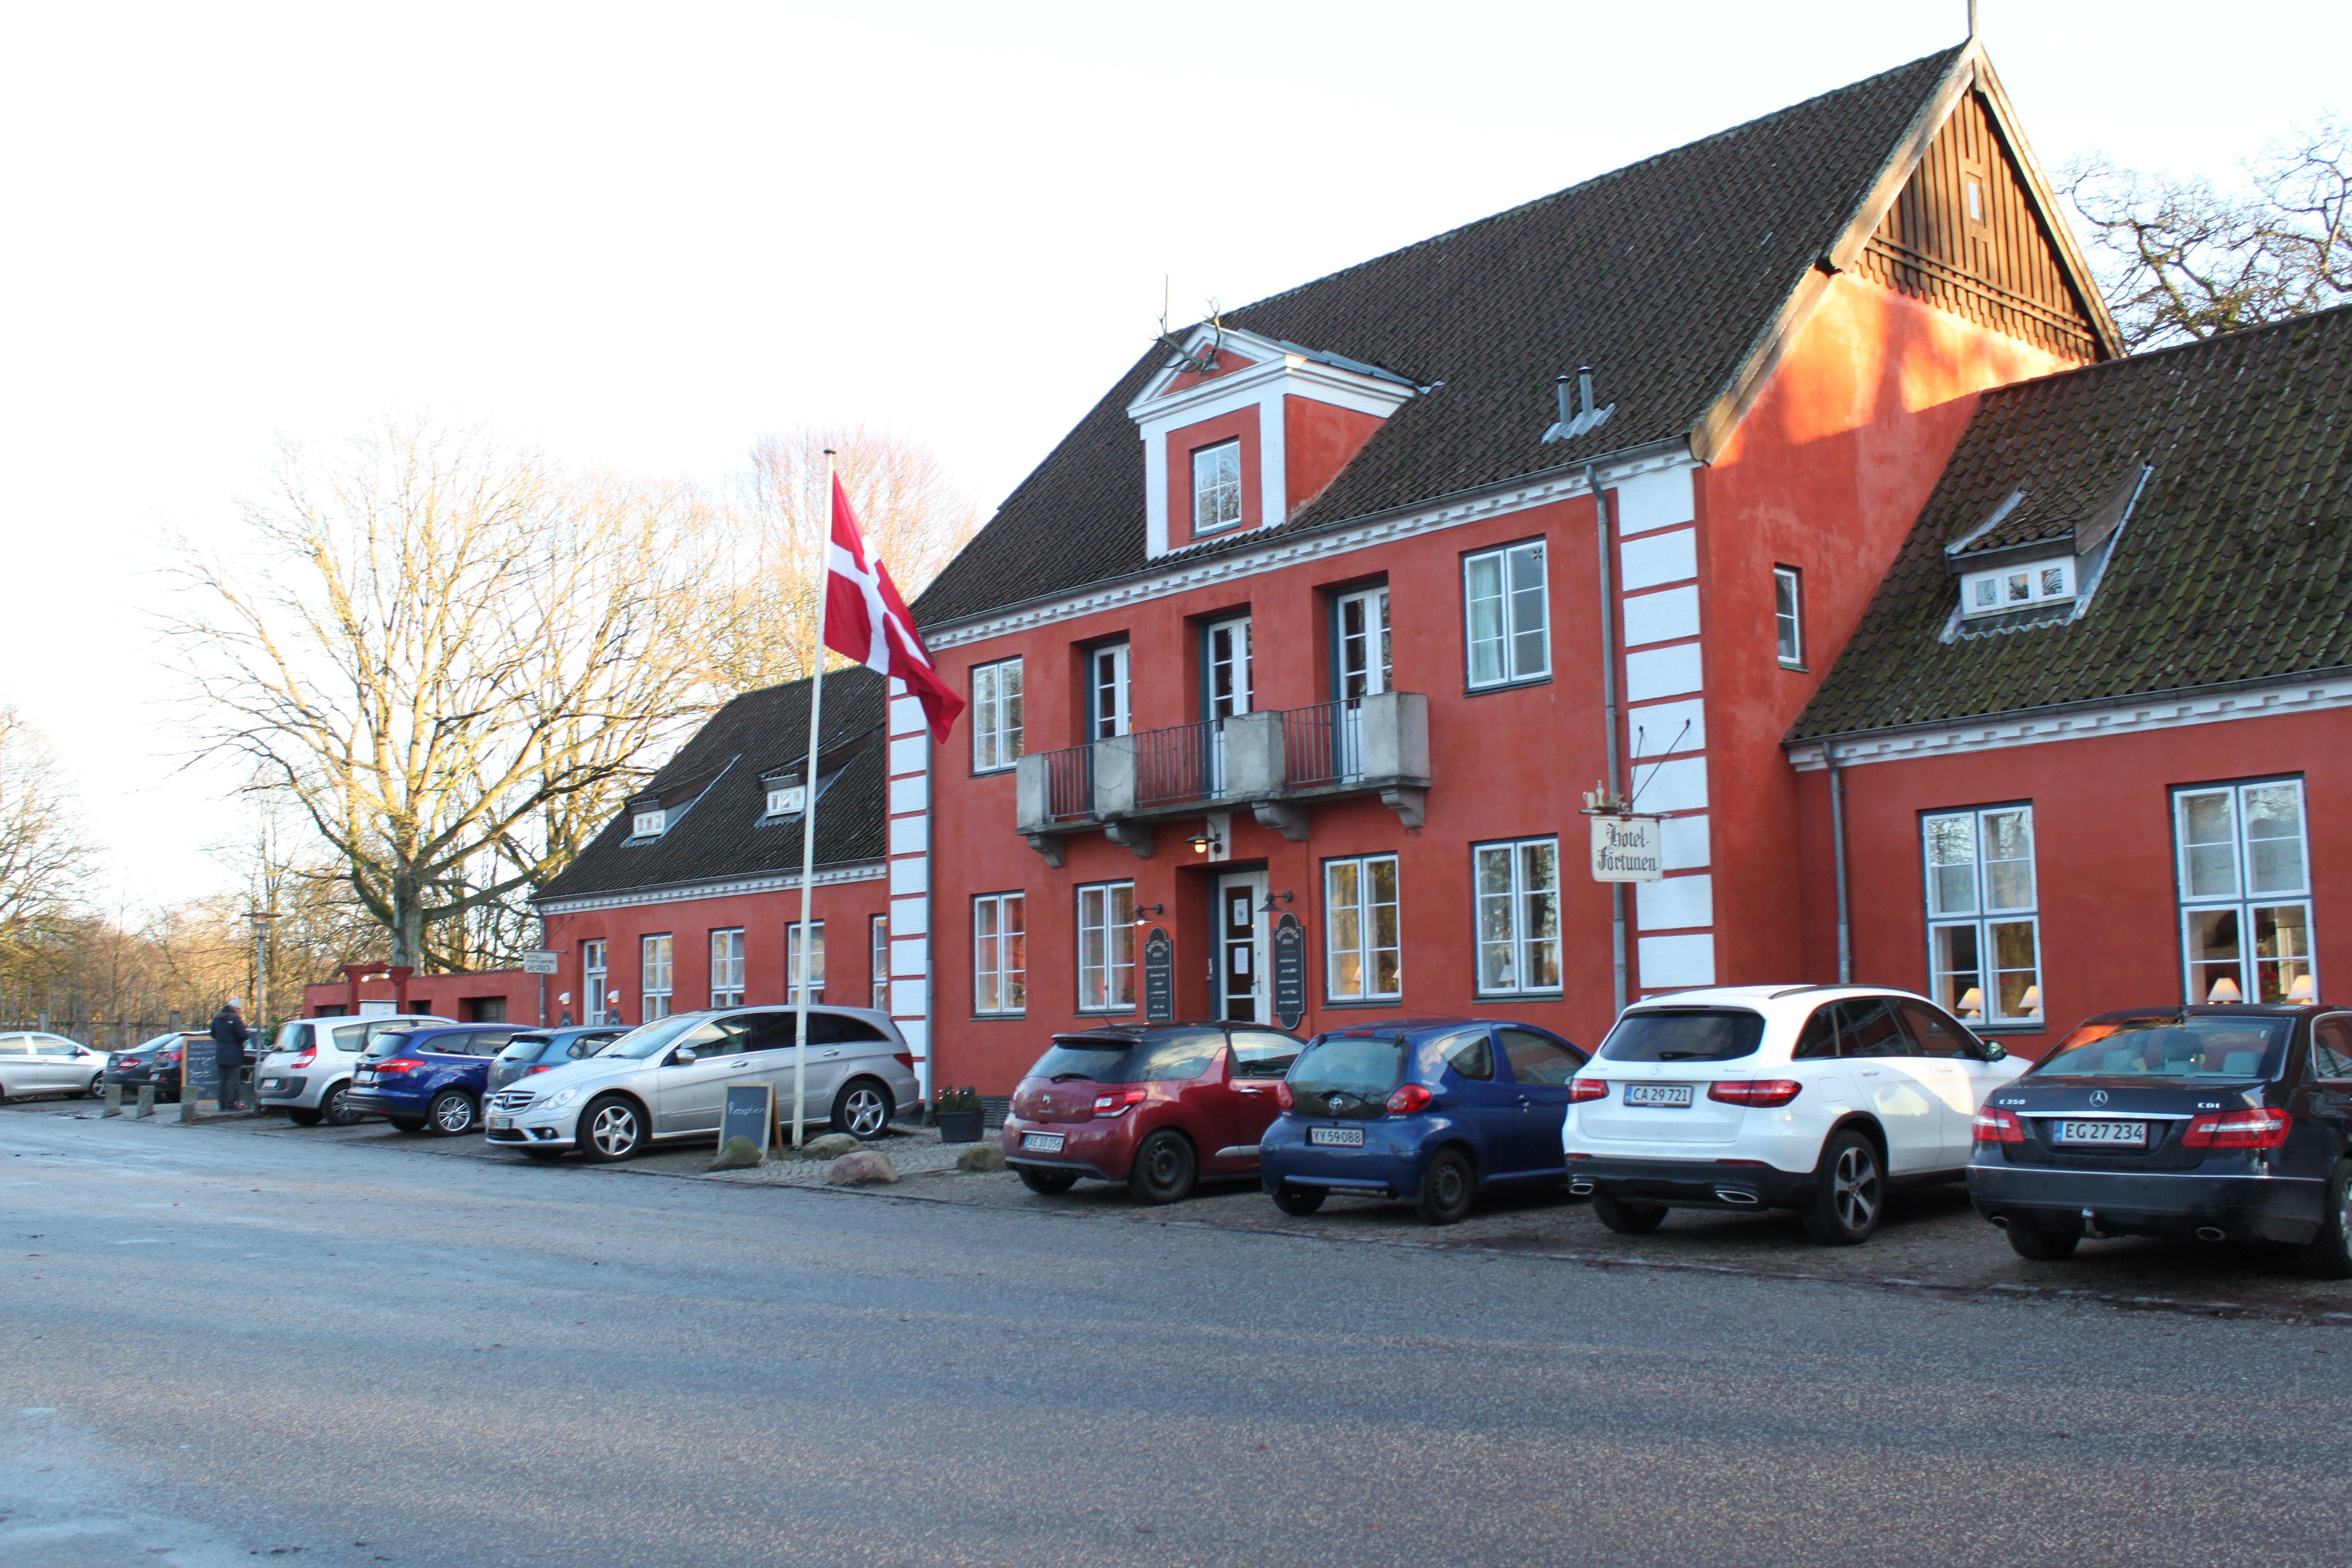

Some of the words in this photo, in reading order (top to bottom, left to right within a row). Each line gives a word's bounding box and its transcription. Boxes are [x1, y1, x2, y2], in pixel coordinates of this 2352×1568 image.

[1607, 823, 1650, 849] Hotel
[1597, 846, 1658, 871] Fortunen
[1633, 1088, 1648, 1100] CA
[1651, 1088, 1665, 1101] 29
[1668, 1089, 1687, 1101] 721
[2065, 1123, 2087, 1138] EG
[2090, 1124, 2110, 1139] 27
[2113, 1125, 2144, 1140] 234
